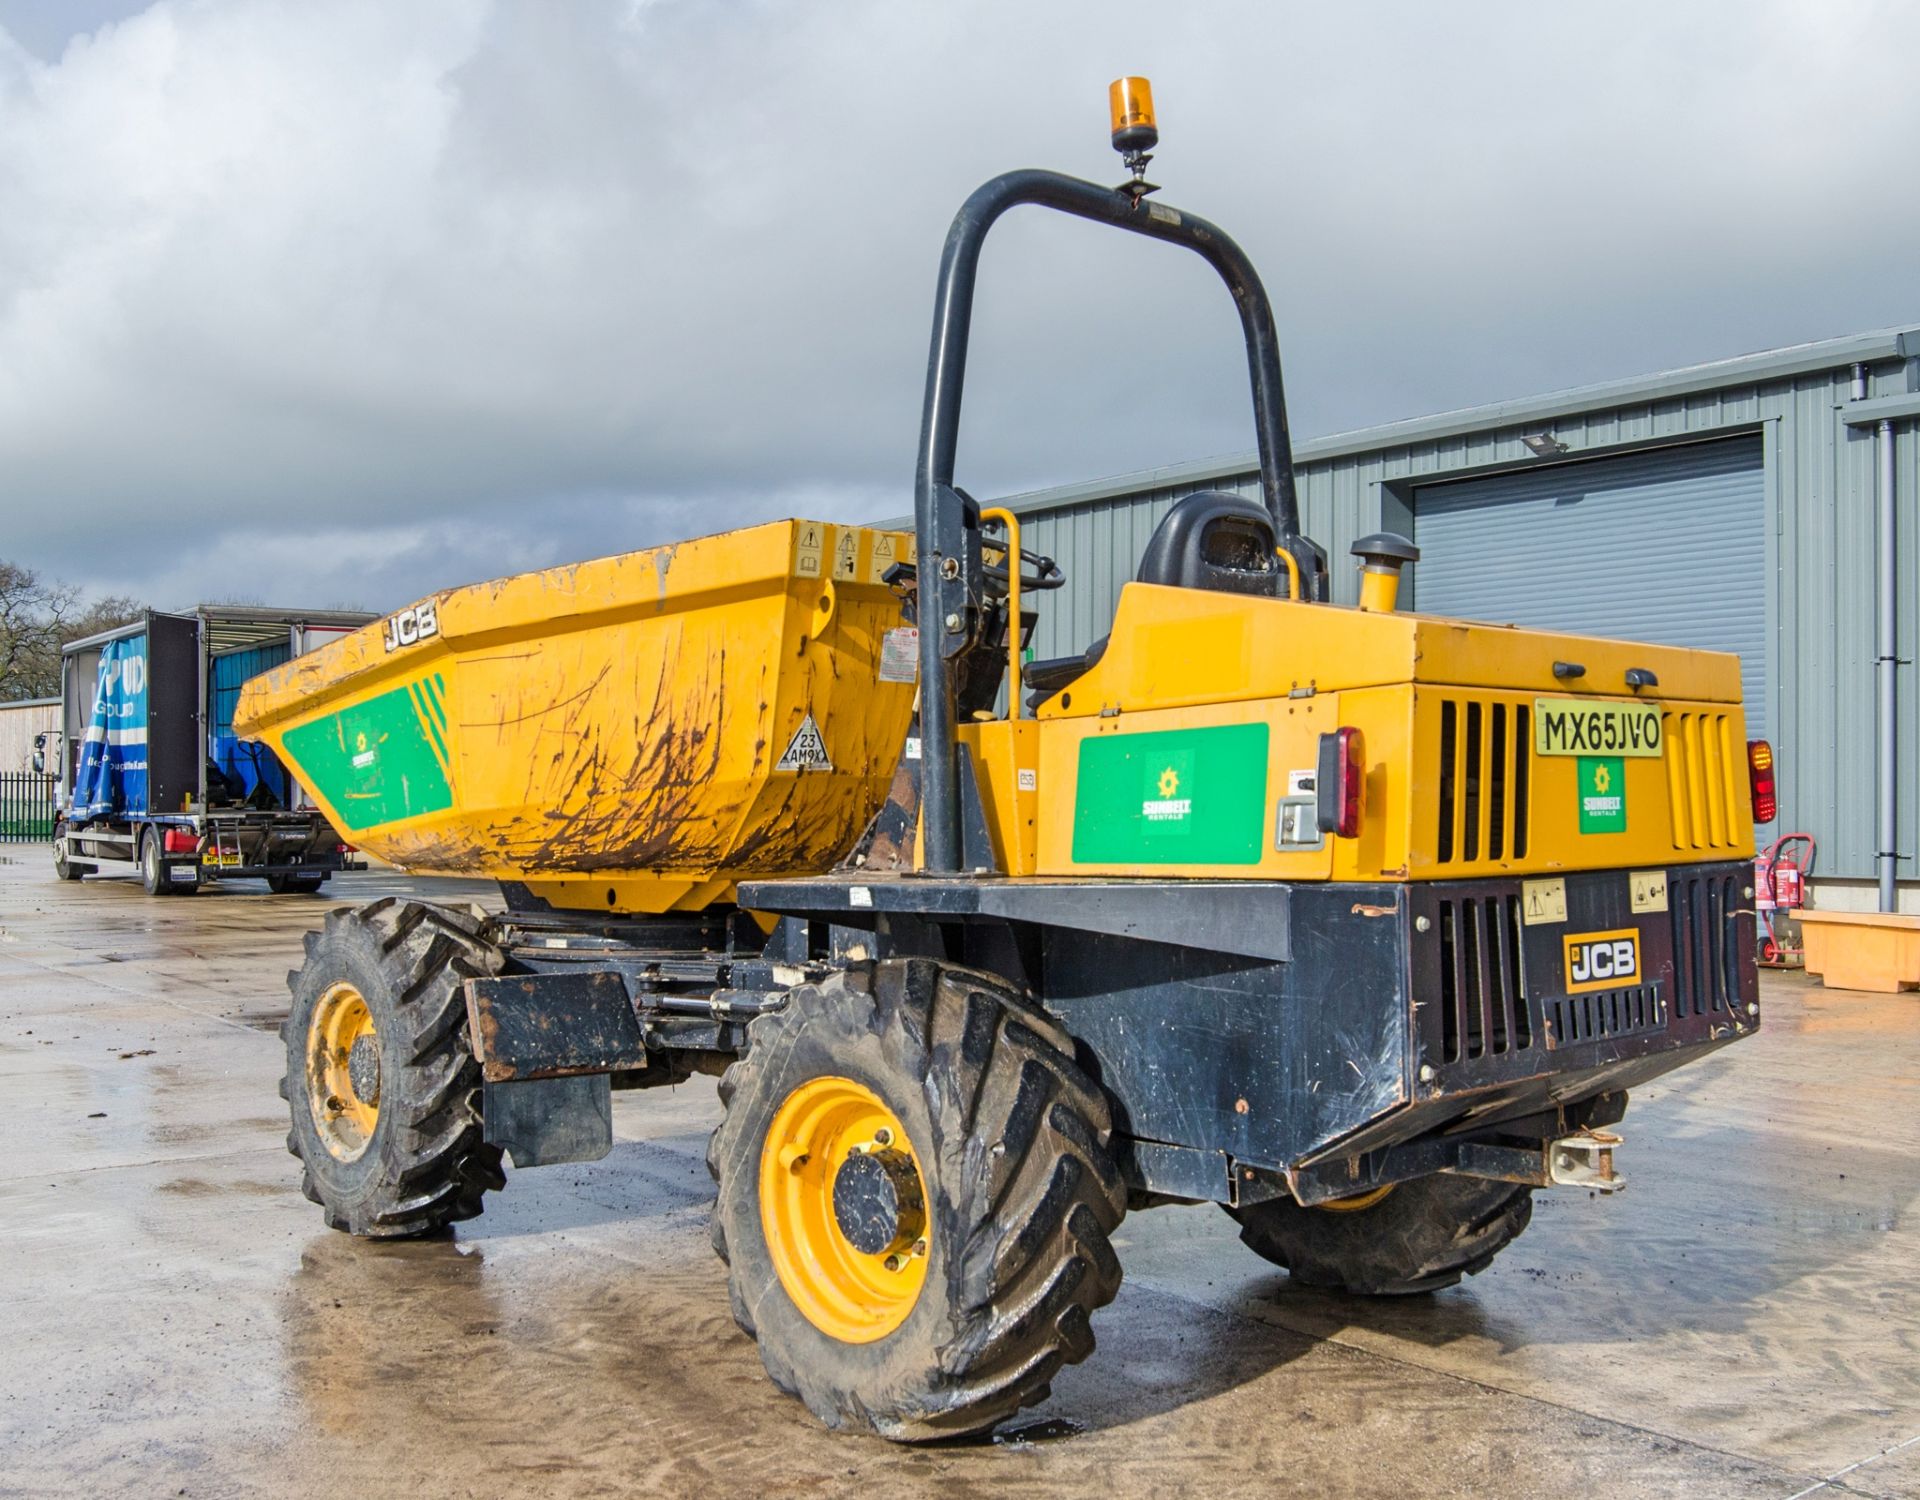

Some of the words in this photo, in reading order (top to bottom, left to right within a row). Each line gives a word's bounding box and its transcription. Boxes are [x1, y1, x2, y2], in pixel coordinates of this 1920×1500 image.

[384, 598, 437, 652] JCB
[799, 733, 816, 749] 23
[1544, 710, 1660, 752] MX65JVO
[790, 748, 823, 763] AM9X
[1142, 799, 1192, 815] SUNBELT
[1571, 941, 1635, 981] JCB
